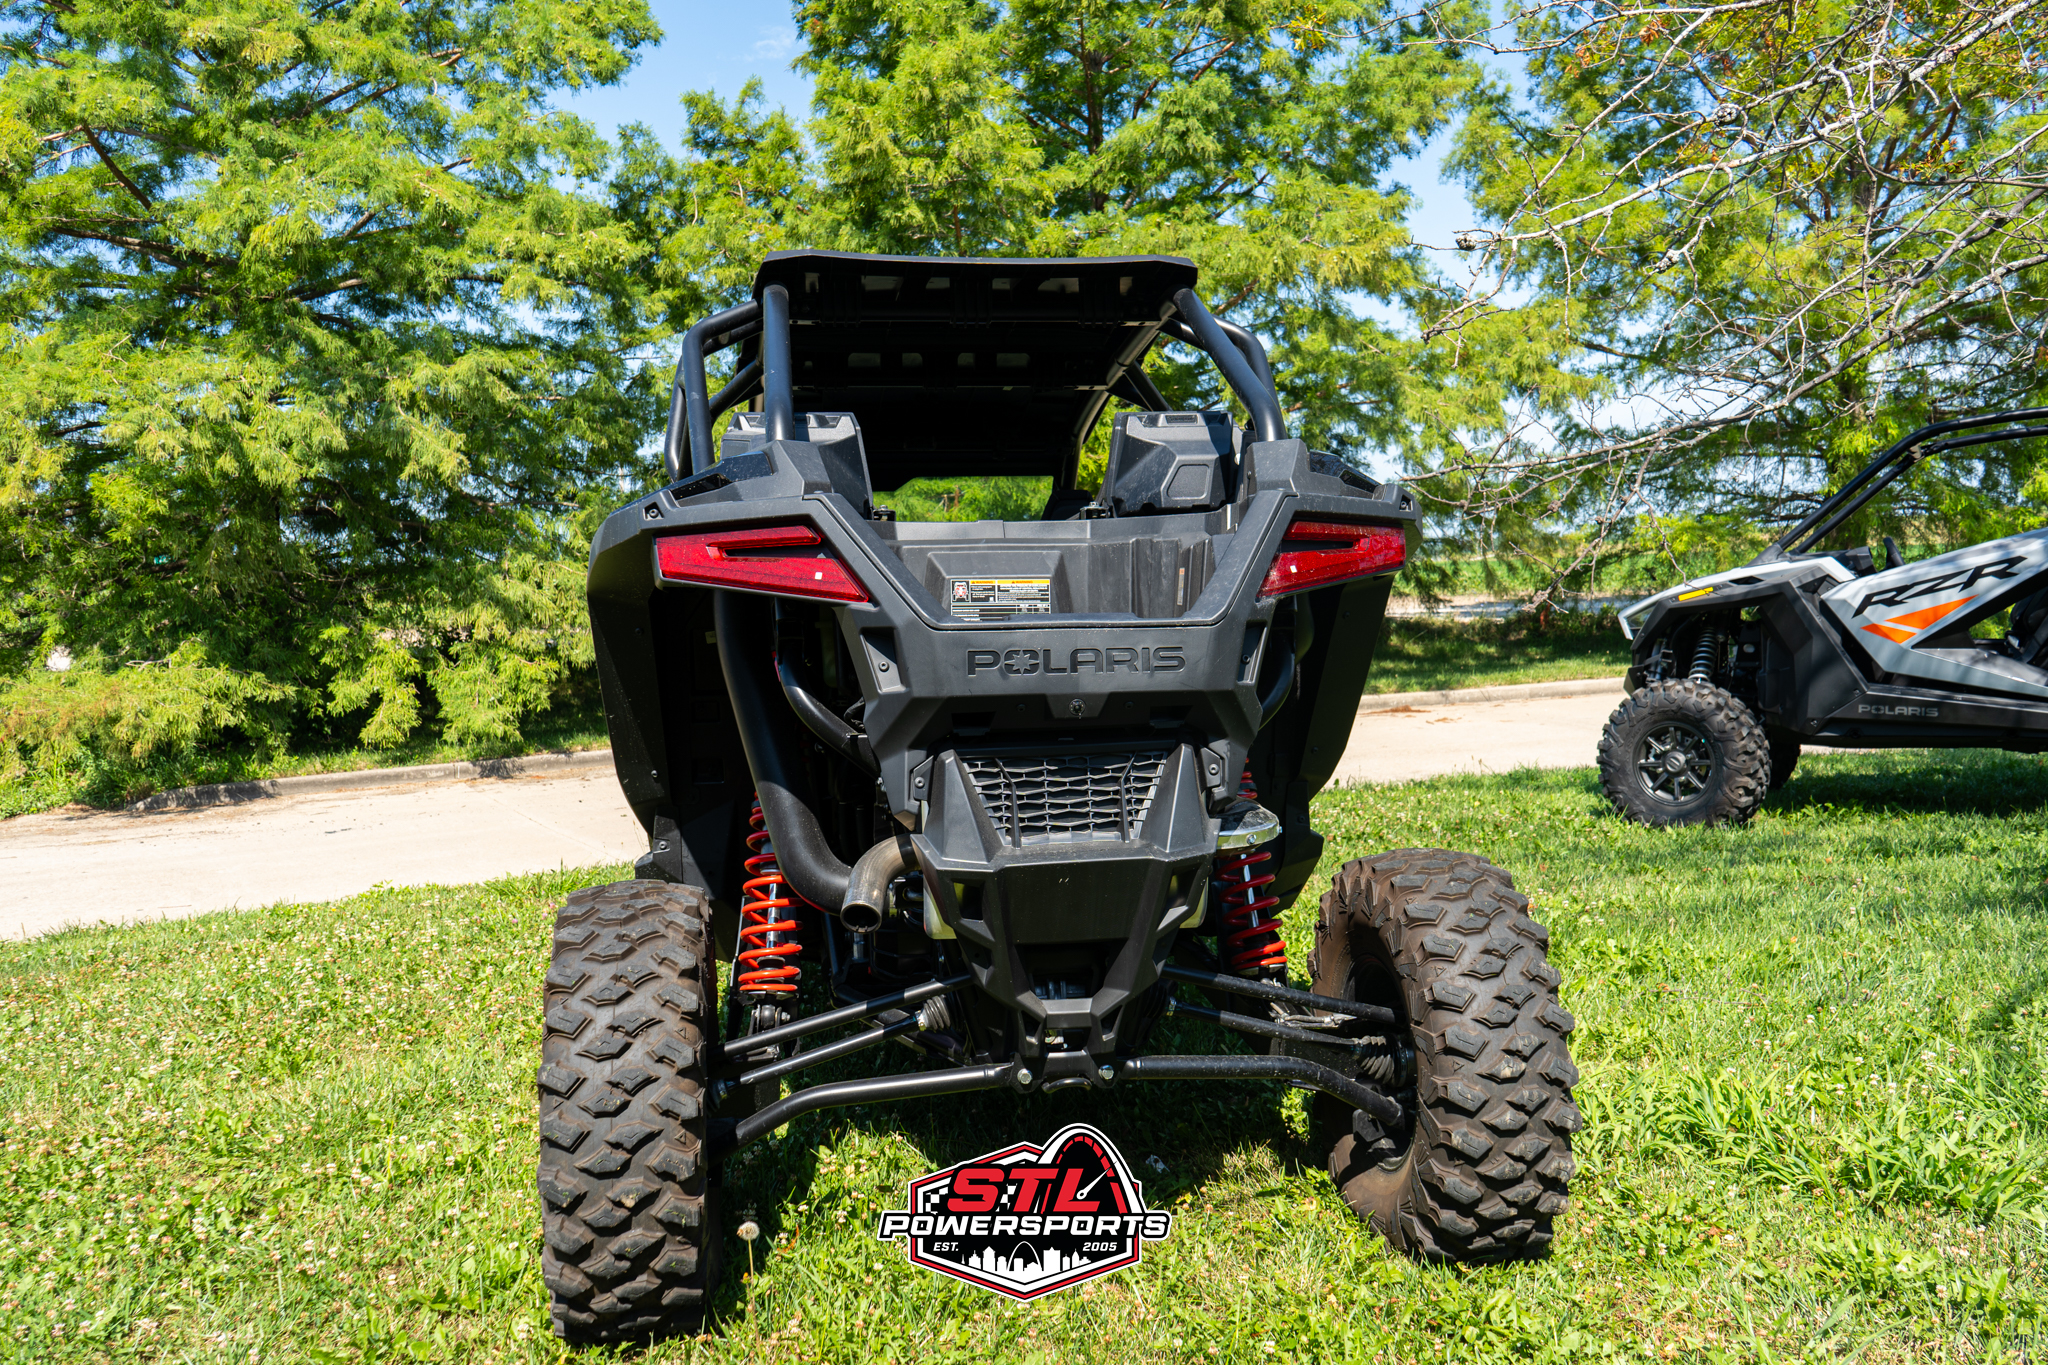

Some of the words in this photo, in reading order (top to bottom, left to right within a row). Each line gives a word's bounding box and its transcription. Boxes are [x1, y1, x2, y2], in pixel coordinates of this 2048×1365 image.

[1852, 555, 2028, 619] RZR
[967, 646, 1186, 677] POLARIS
[1858, 704, 1939, 717] POLARIS
